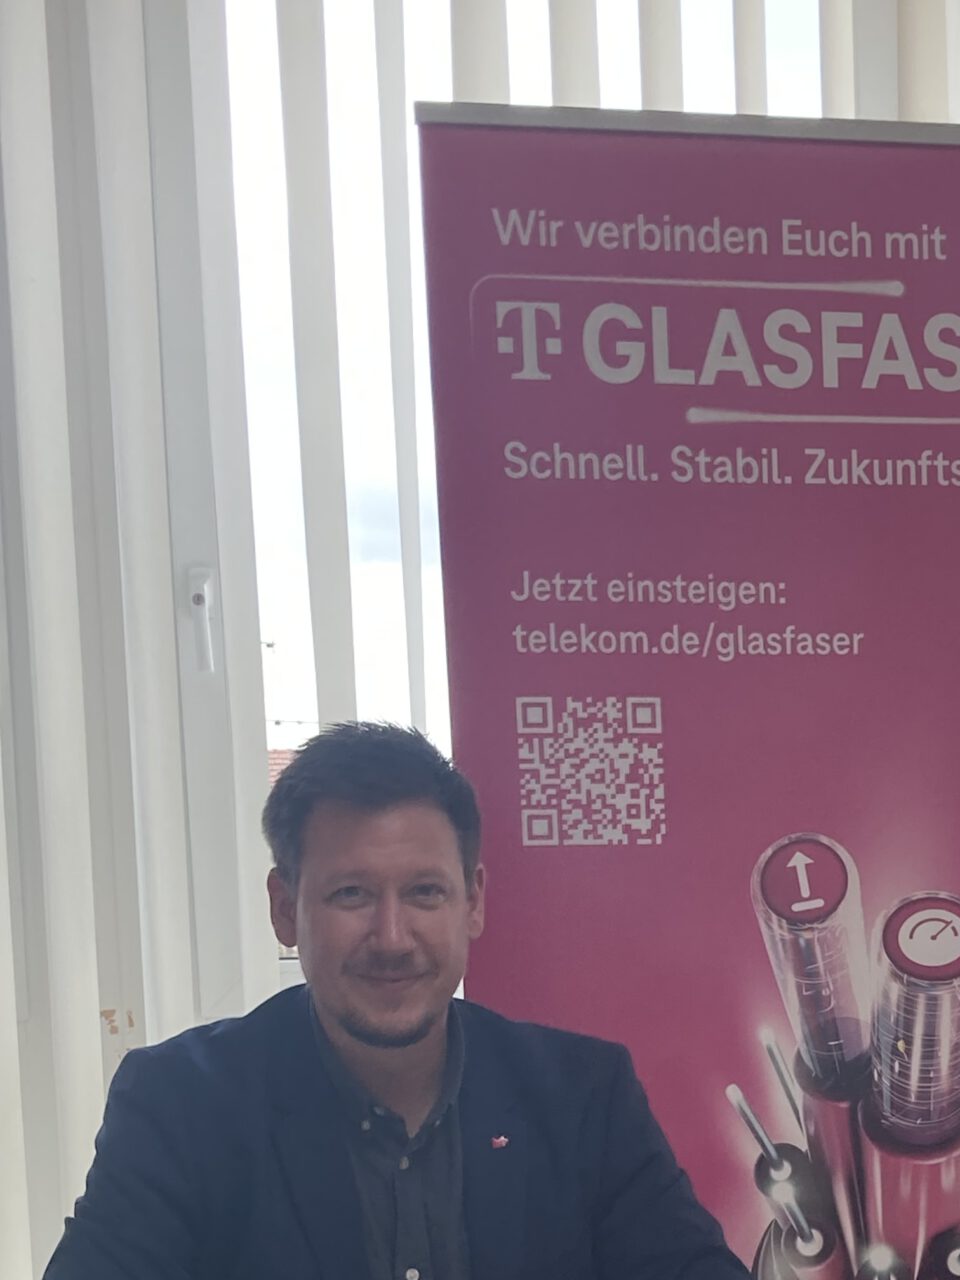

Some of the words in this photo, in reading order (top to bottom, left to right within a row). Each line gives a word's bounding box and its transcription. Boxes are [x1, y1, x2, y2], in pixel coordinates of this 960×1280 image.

[492, 208, 564, 247] Wir
[574, 213, 768, 255] verbinden
[782, 219, 873, 259] Euch
[885, 224, 948, 261] mit
[496, 301, 562, 381] T
[504, 441, 660, 482] Schnell.
[671, 445, 793, 486] Stabil.
[511, 571, 598, 603] Jetzt
[607, 573, 788, 612] einsteigen:
[512, 622, 865, 662] telekom.de/glasfaser
